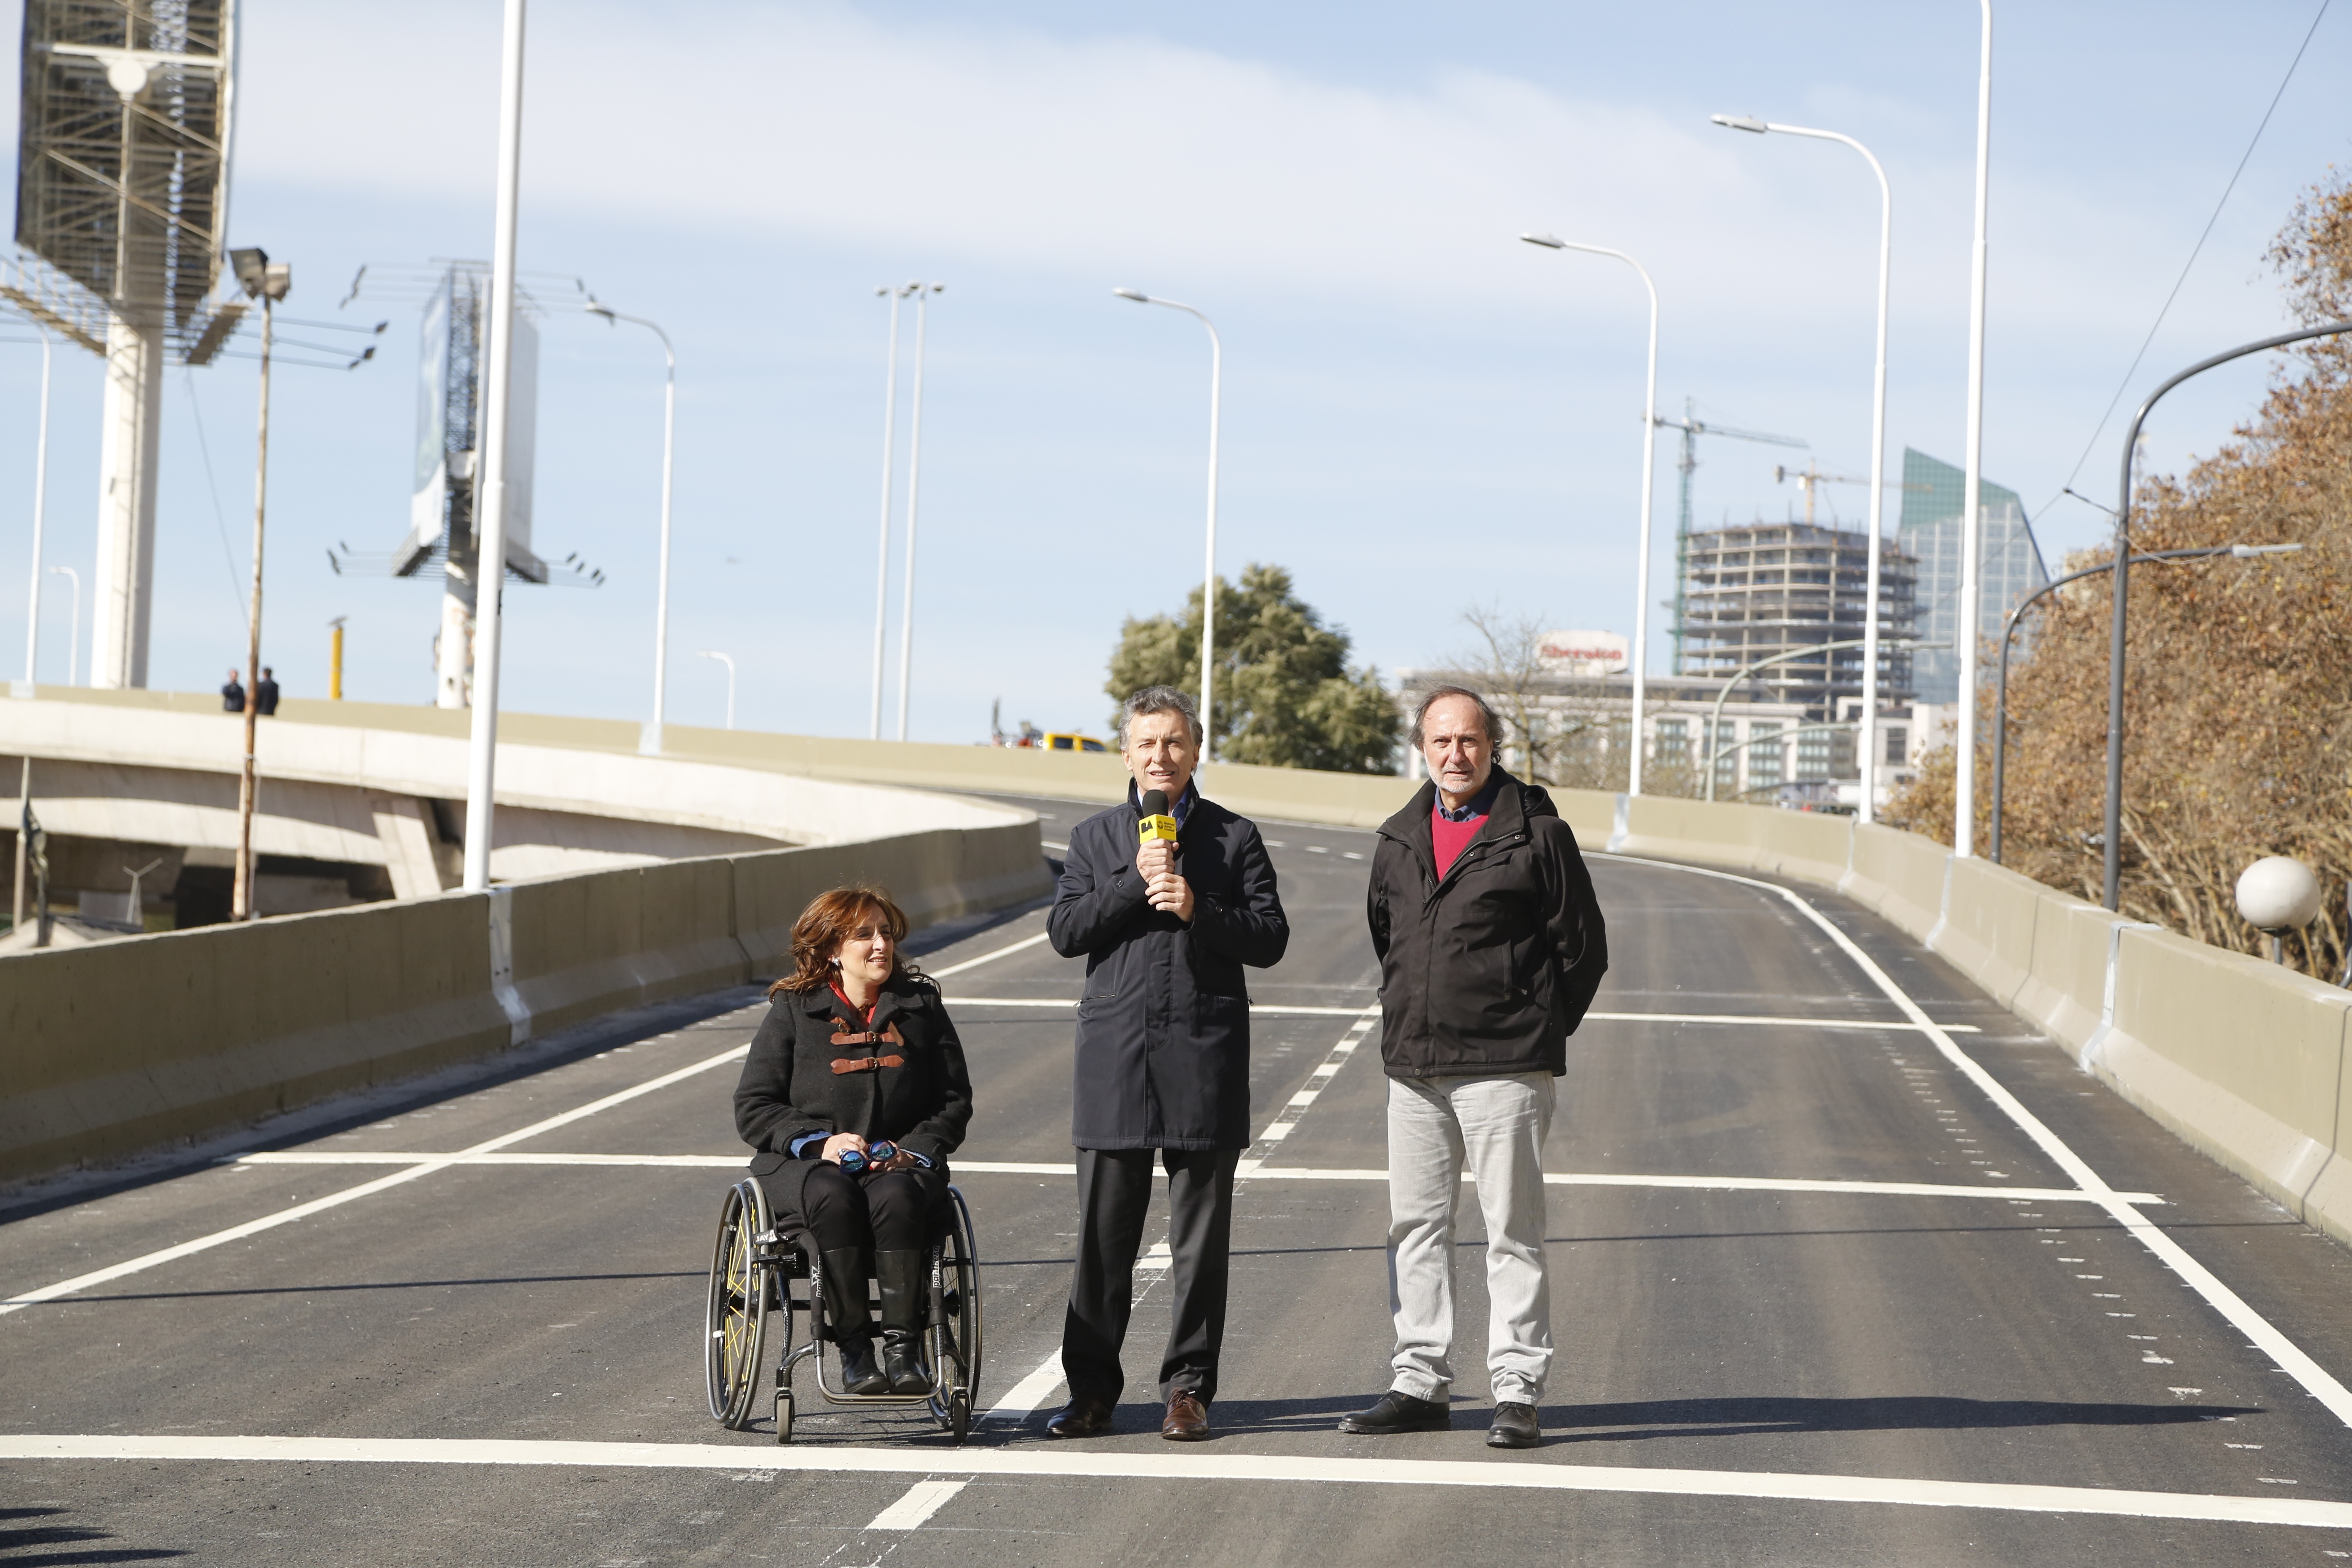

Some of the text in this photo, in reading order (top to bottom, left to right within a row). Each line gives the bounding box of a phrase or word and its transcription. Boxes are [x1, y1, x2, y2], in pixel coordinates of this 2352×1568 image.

[1541, 644, 1621, 659] Sheraton
[1141, 820, 1153, 833] BA
[756, 1234, 768, 1242] JAY
[931, 1245, 942, 1288] panthera
